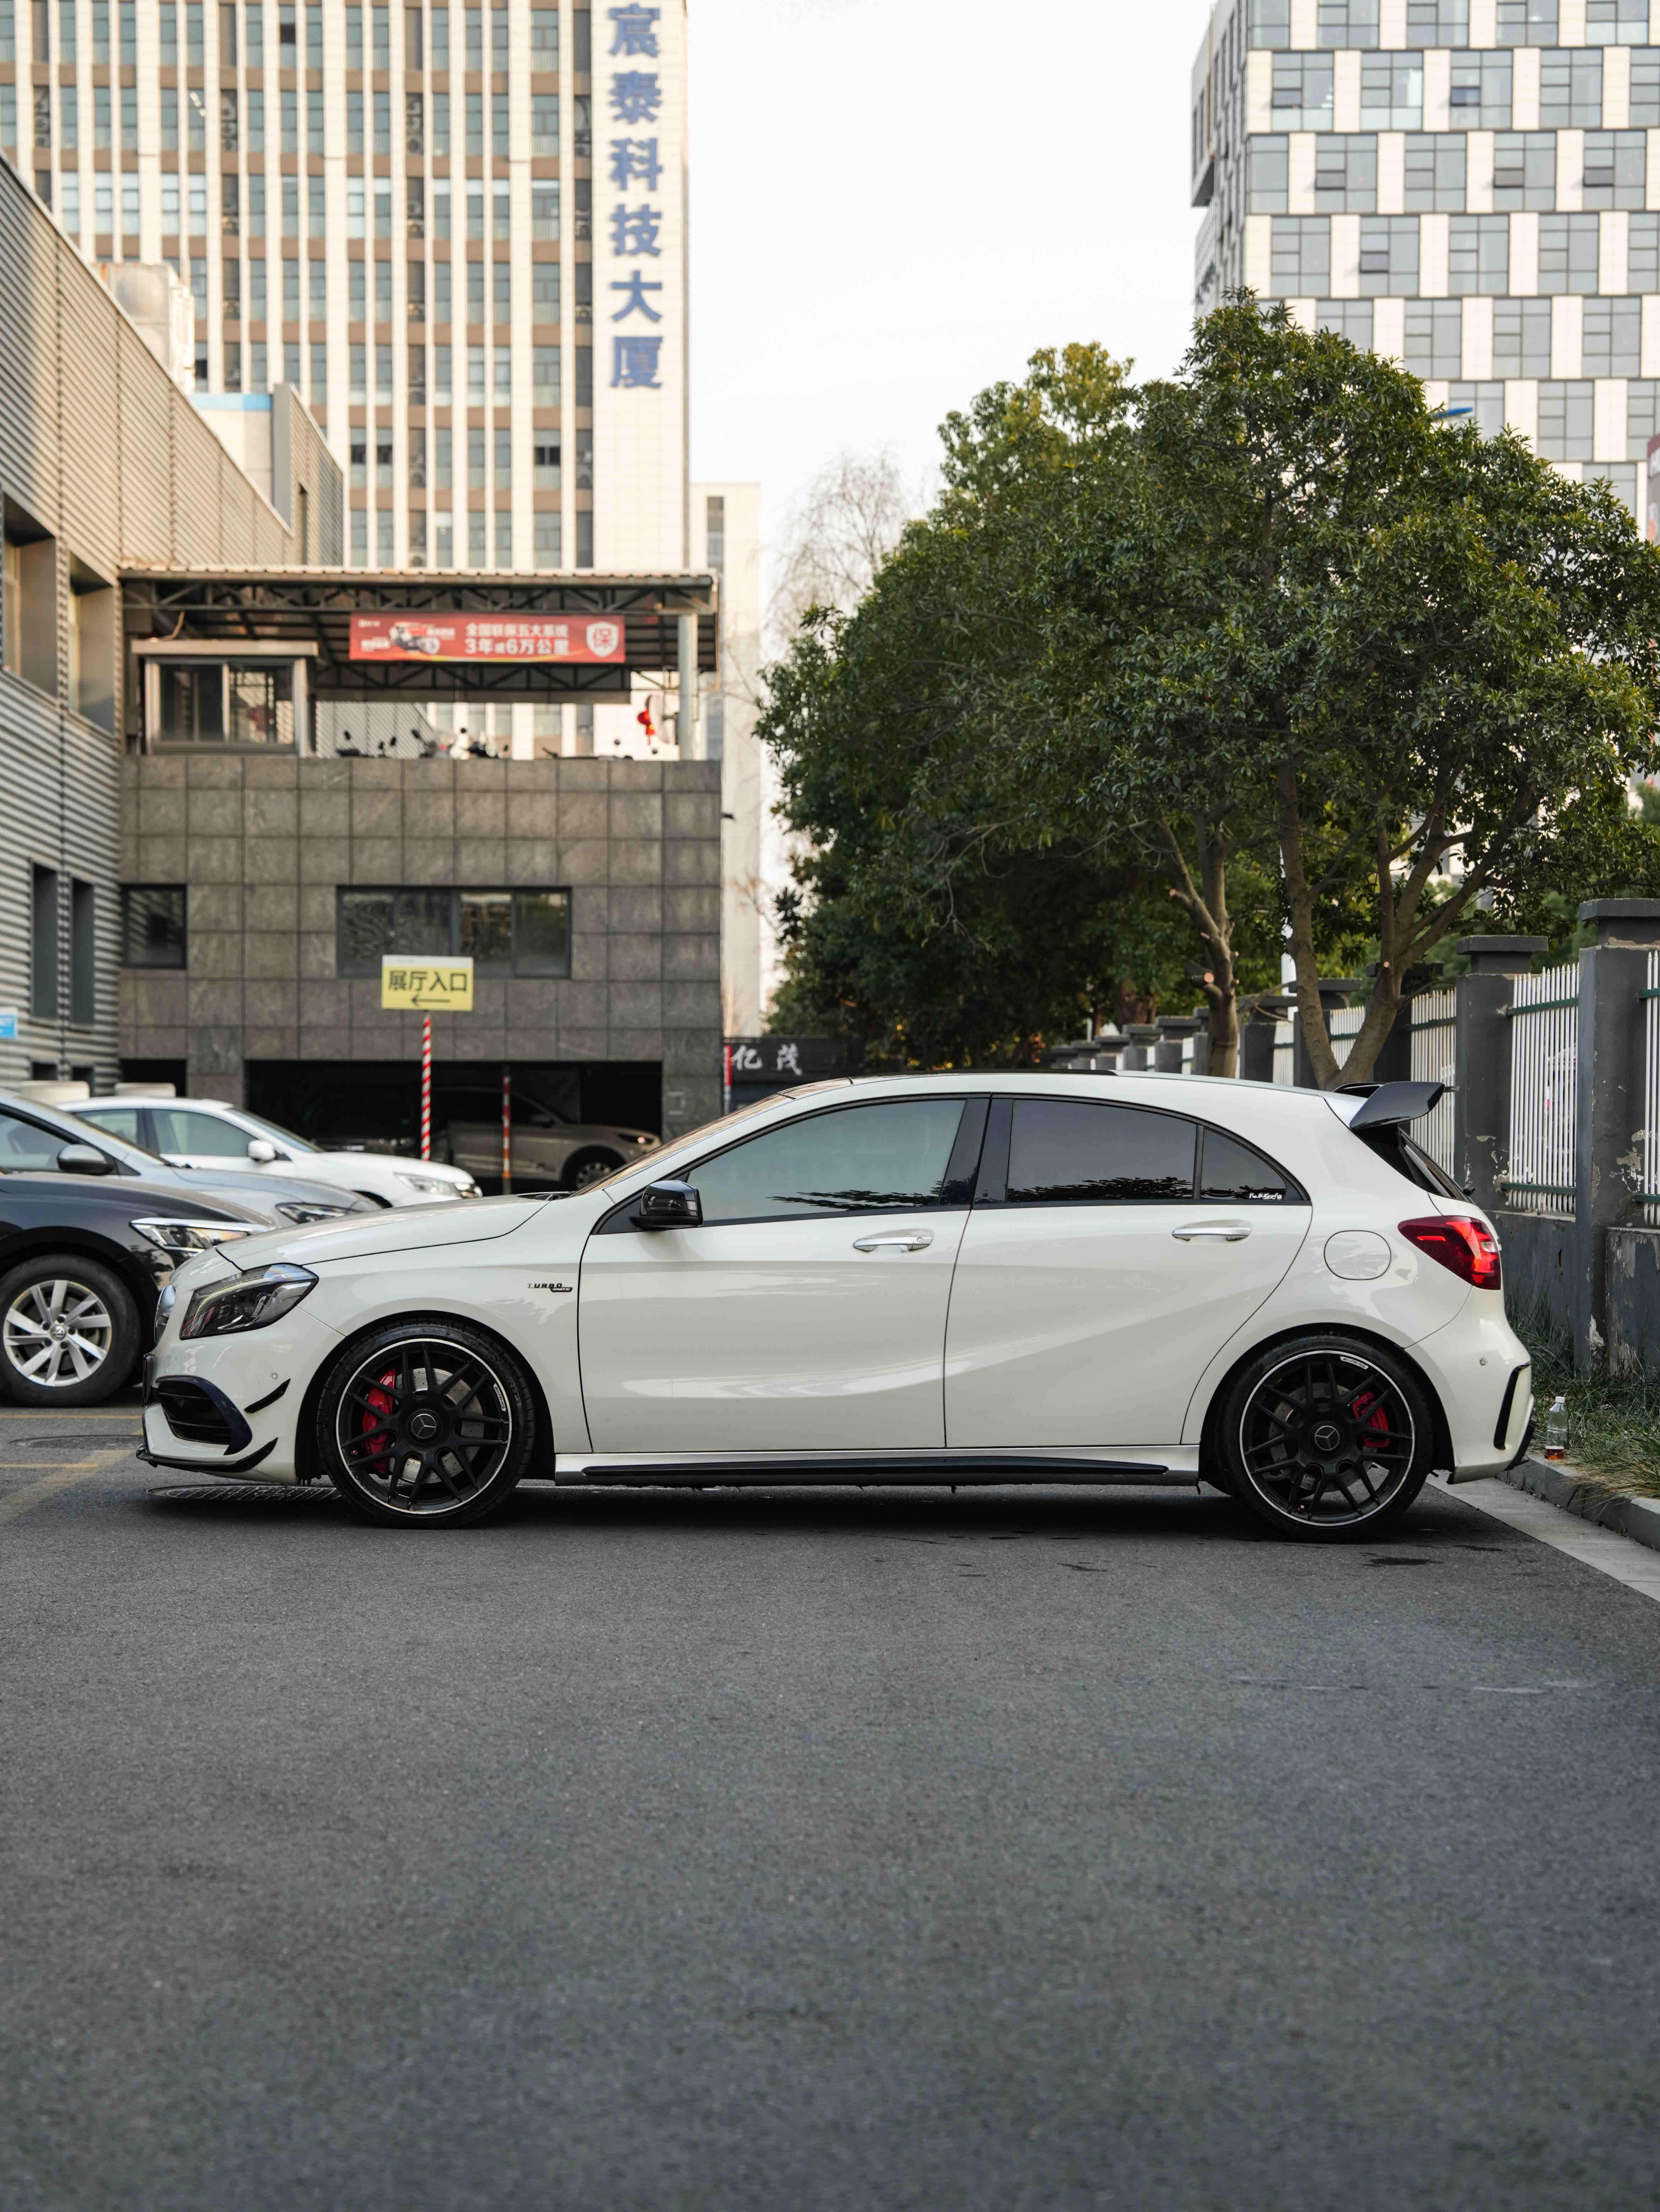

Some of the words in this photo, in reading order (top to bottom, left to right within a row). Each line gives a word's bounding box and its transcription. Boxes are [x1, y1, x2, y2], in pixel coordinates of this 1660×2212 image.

[608, 3, 663, 388] 宸泰科技大厦
[388, 970, 467, 991] 展厅入口
